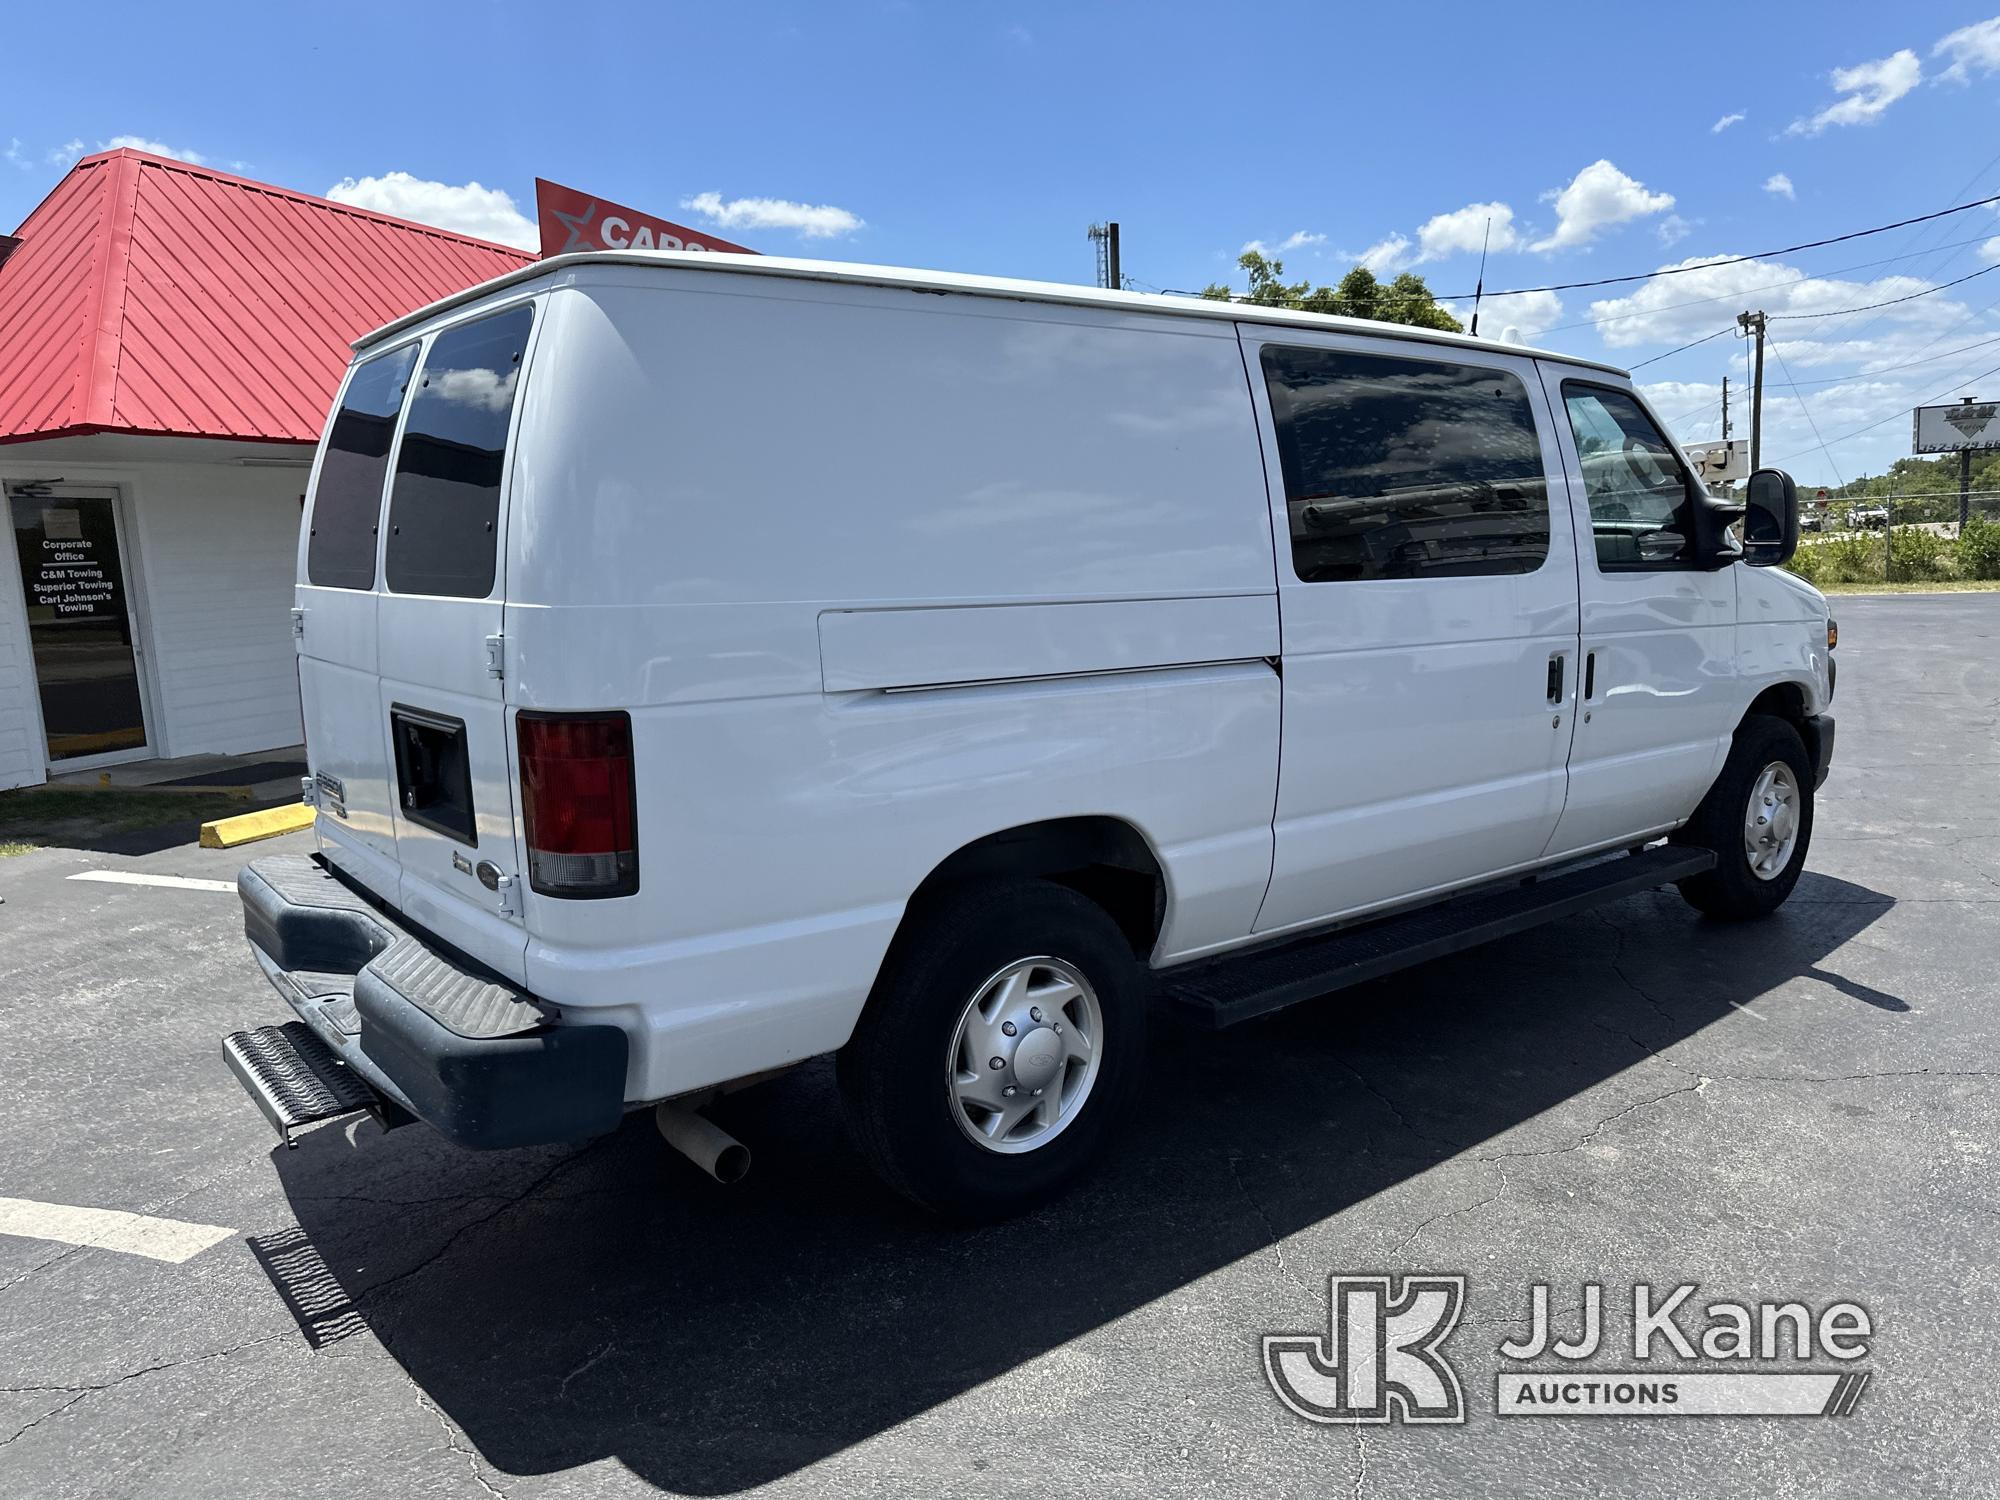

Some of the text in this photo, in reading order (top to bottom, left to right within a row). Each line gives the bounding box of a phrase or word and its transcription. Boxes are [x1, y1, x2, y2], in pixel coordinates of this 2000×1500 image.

[42, 540, 93, 550] Corporate
[54, 552, 85, 561] Office
[41, 569, 103, 579] C&M Towing
[33, 580, 113, 593] Superior Towing
[39, 592, 112, 604] Carl Johnson's
[57, 603, 94, 612] Towing
